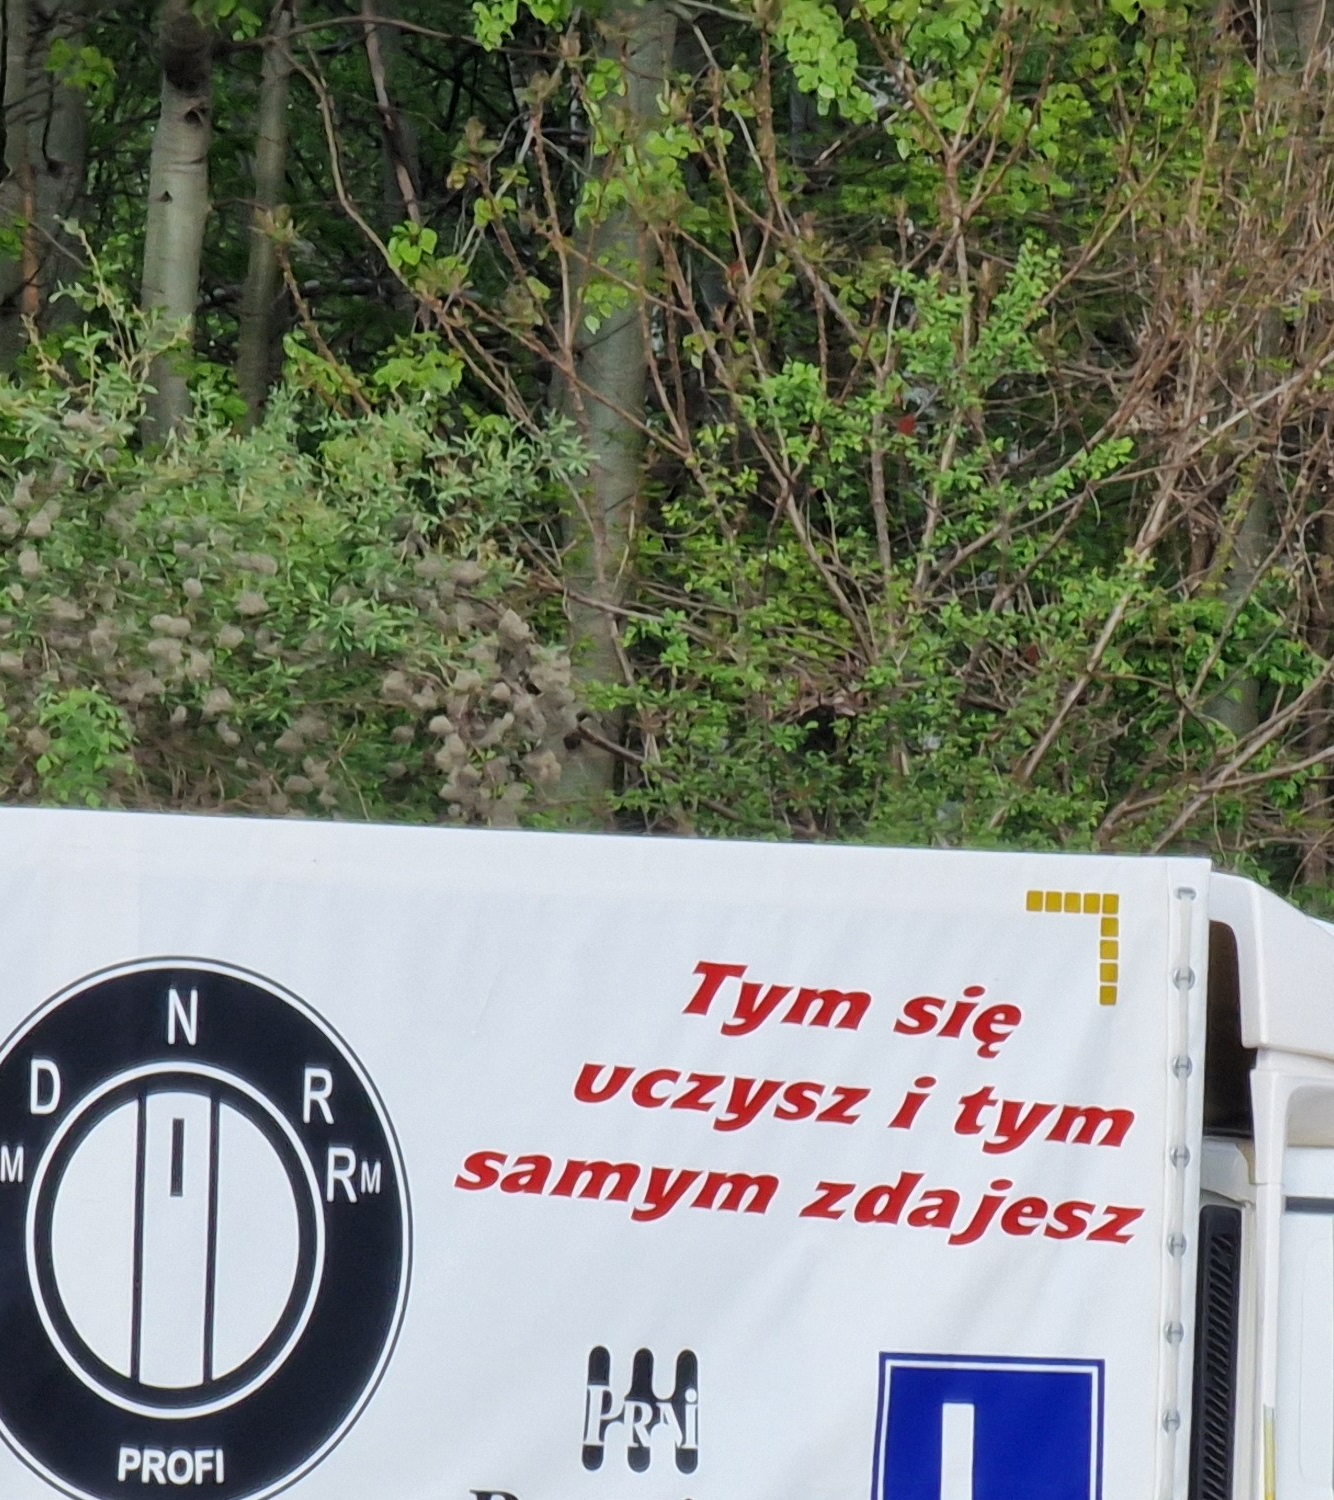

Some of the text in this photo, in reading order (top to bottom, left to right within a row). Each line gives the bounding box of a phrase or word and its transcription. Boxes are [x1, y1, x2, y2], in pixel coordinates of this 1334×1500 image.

[167, 988, 198, 1045] N
[683, 960, 1022, 1059] Tym się
[30, 1058, 61, 1115] D
[303, 1067, 334, 1124] R
[573, 1063, 1136, 1154] uczysz i tym
[454, 1150, 1145, 1245] samym zdajesz
[117, 1446, 225, 1485] PROFI
